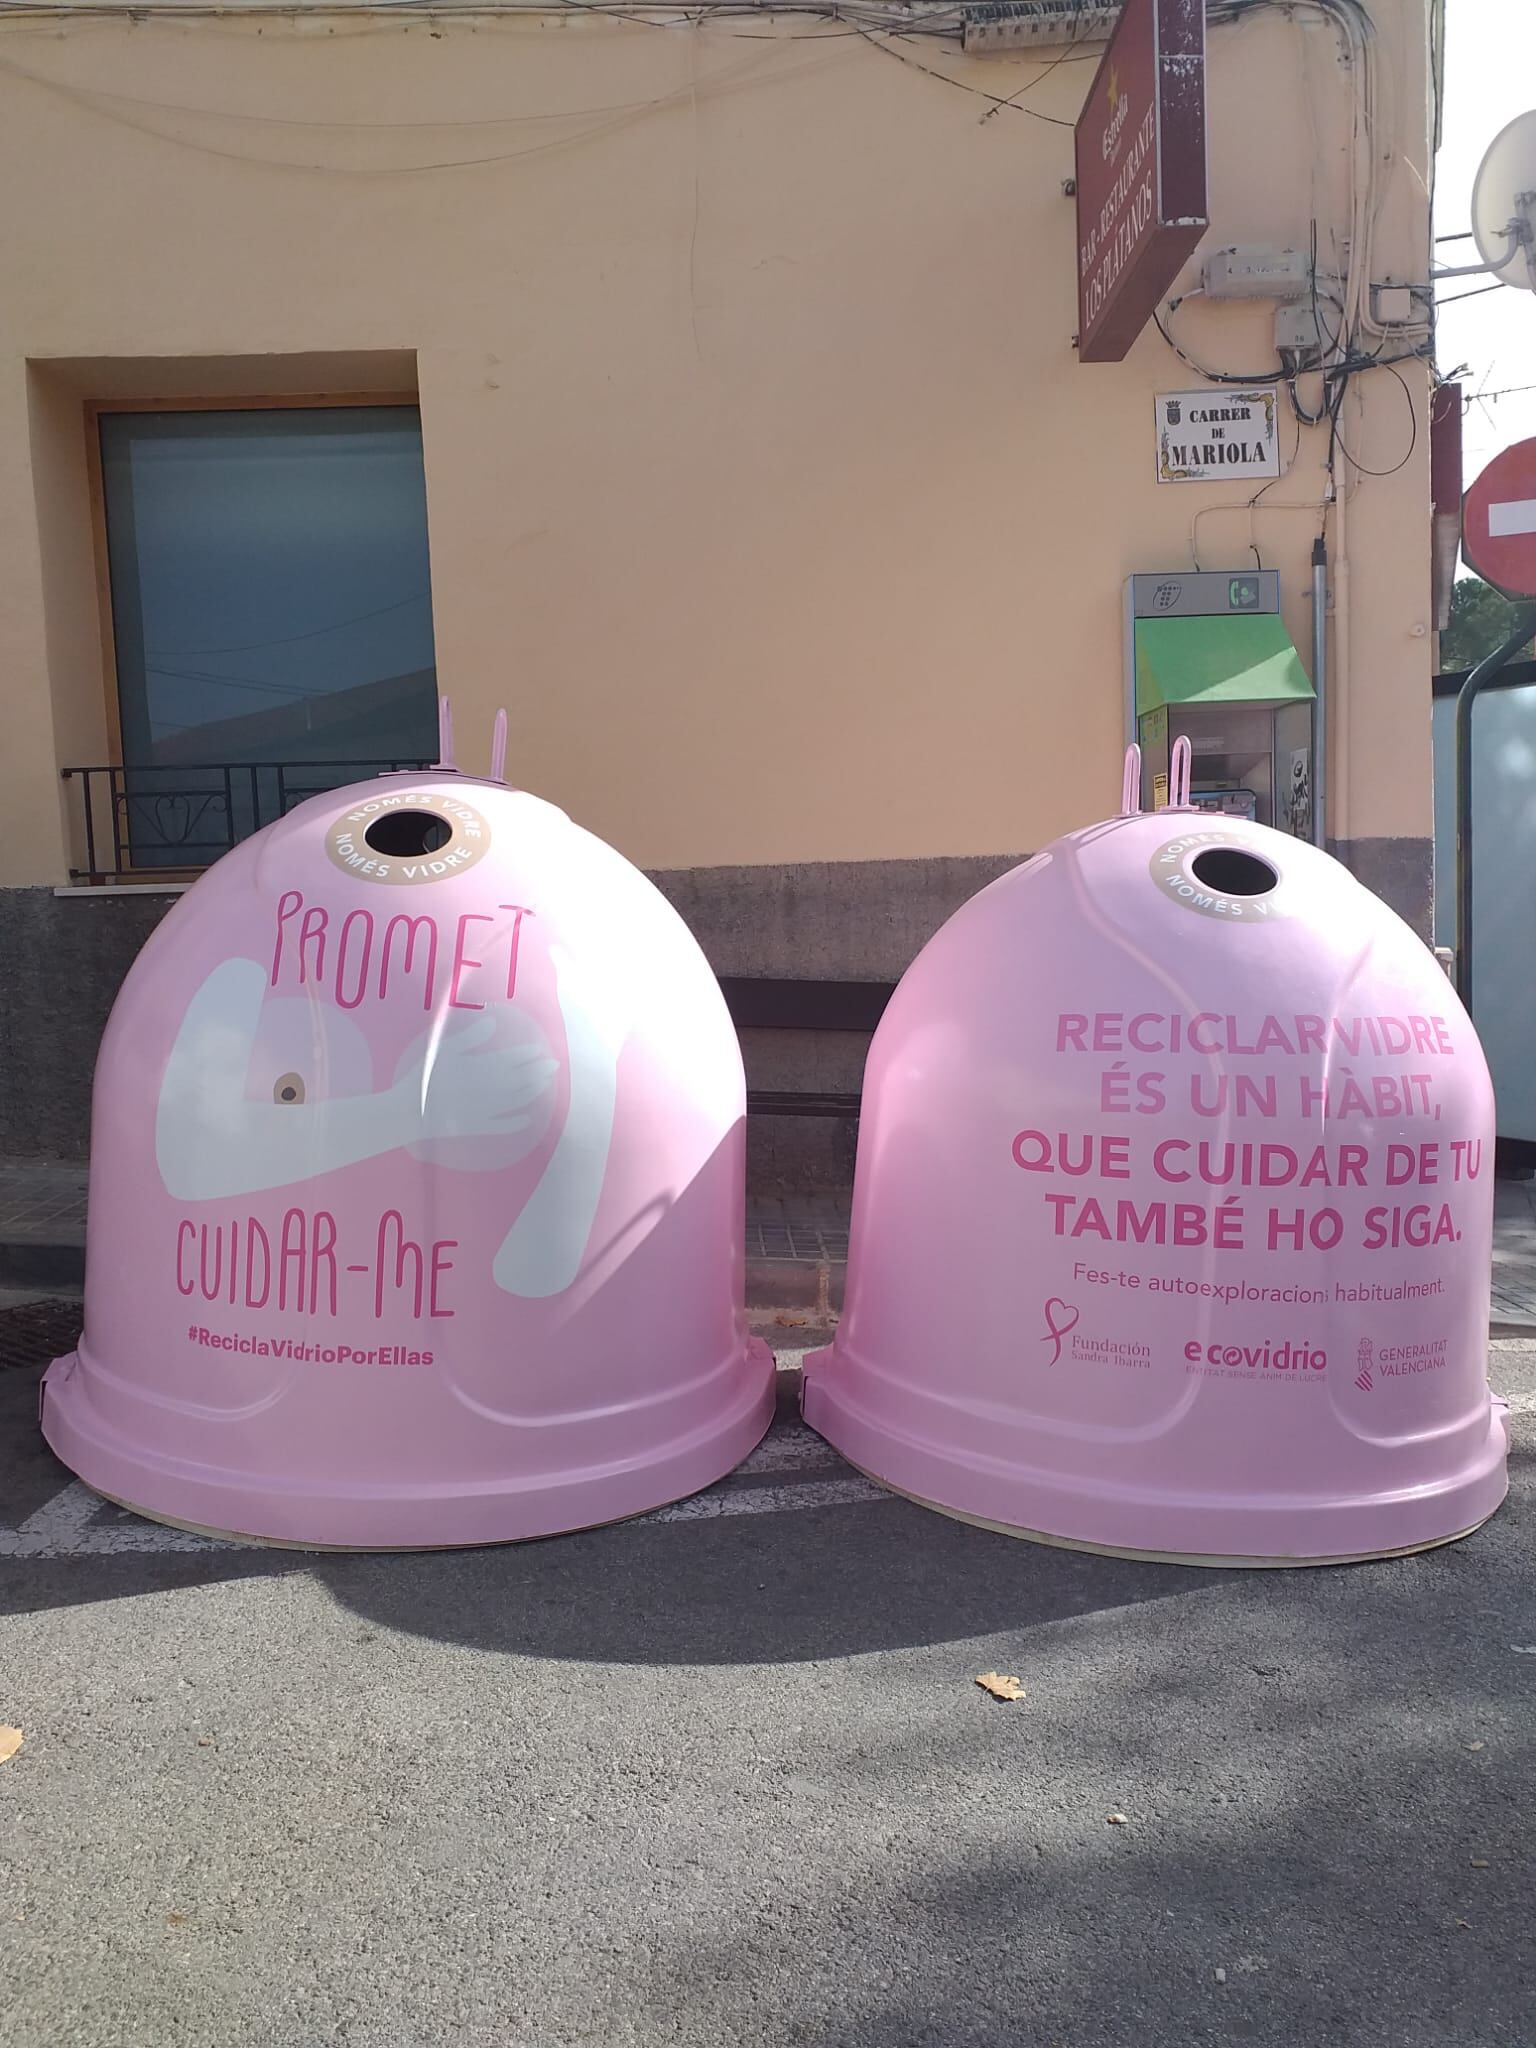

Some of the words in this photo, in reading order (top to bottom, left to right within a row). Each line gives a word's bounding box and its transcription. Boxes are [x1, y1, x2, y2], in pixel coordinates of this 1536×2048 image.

[1100, 100, 1155, 243] RESTAURANTE
[1085, 268, 1101, 329] LOS
[1103, 168, 1152, 300] PLÁTANOS
[1189, 407, 1251, 423] CARRER
[1211, 428, 1225, 439] DE
[1172, 441, 1266, 466] MARIOLA
[348, 795, 432, 822] NOMÉS
[442, 801, 481, 838] VIDRE
[336, 832, 391, 877] NOMÉS
[402, 846, 473, 879] VIDRE
[1166, 874, 1243, 915] NOMÉS
[271, 890, 536, 1011] PROMET
[1056, 1012, 1328, 1055] RECICLAR
[1333, 1015, 1455, 1057] VIDRE
[1101, 1061, 1166, 1115] ÉS
[1191, 1074, 1277, 1118] UN
[1300, 1067, 1441, 1121] HÀBIT,
[1011, 1129, 1130, 1179] QUE
[1153, 1139, 1369, 1187] CUIDAR
[1386, 1143, 1439, 1186] DE
[1450, 1138, 1481, 1182] TU
[1044, 1193, 1244, 1250] TAMBÉ
[1267, 1207, 1344, 1251] HO
[1362, 1203, 1462, 1250] SIGA.
[1073, 1262, 1141, 1289] Fes-te
[1335, 1278, 1446, 1302] habitualment.
[188, 1325, 435, 1366] #ReciclaVidrioPorEllas
[1071, 1335, 1150, 1358] Fundación
[1071, 1350, 1109, 1364] Sandra
[1113, 1354, 1150, 1369] Ibarra
[1184, 1340, 1327, 1370] ecovidrio
[1379, 1339, 1448, 1361] GENERALITAT
[1380, 1357, 1446, 1377] VALENCIANA
